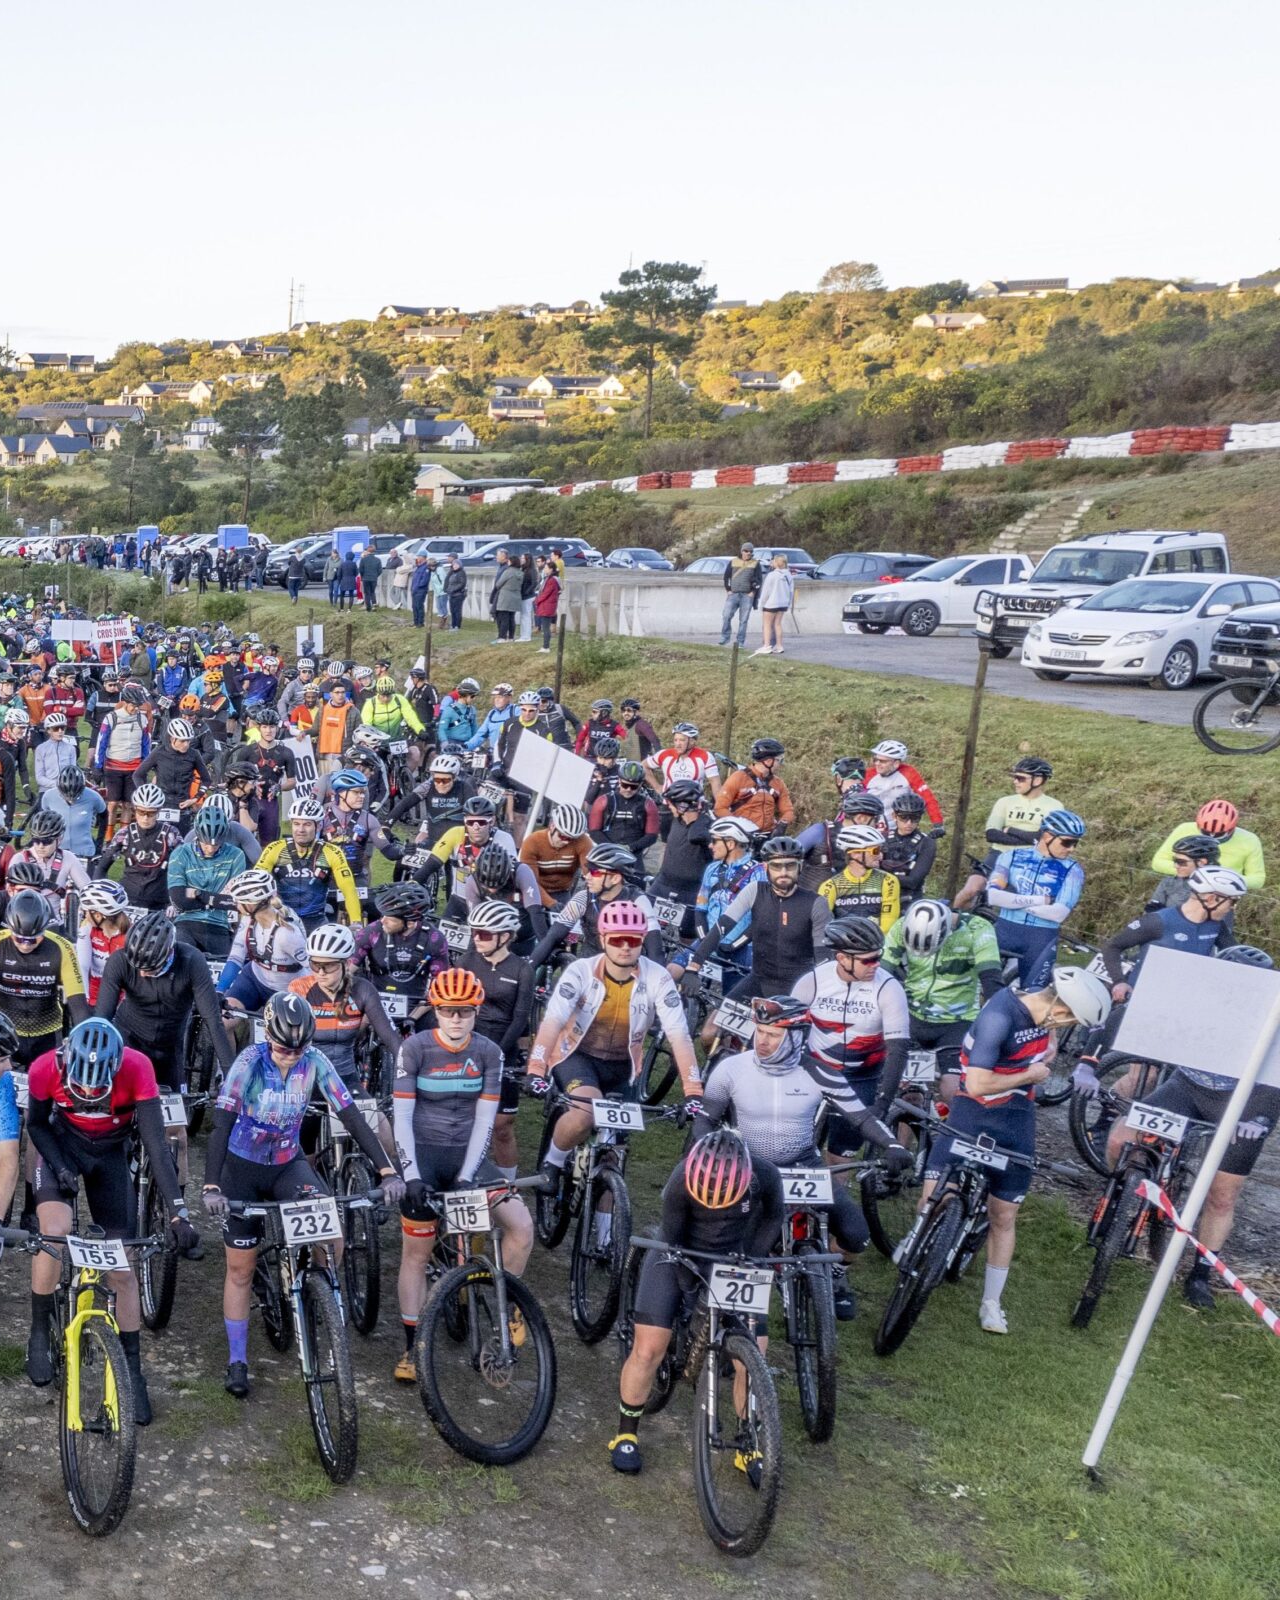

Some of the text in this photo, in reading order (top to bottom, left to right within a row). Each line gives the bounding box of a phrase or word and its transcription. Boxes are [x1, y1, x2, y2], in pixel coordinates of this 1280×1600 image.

[406, 853, 426, 866] 228
[657, 905, 678, 919] 169
[443, 929, 465, 944] 199
[2, 972, 56, 983] CROWN
[817, 997, 877, 1010] FREEWHEEL
[818, 1004, 874, 1016] CYCOLOGY
[606, 1109, 633, 1125] 80
[1138, 1112, 1175, 1134] 167
[788, 1181, 818, 1199] 42
[453, 1205, 478, 1227] 115
[292, 1213, 336, 1238] 232
[77, 1247, 119, 1267] 155
[725, 1280, 755, 1305] 20
